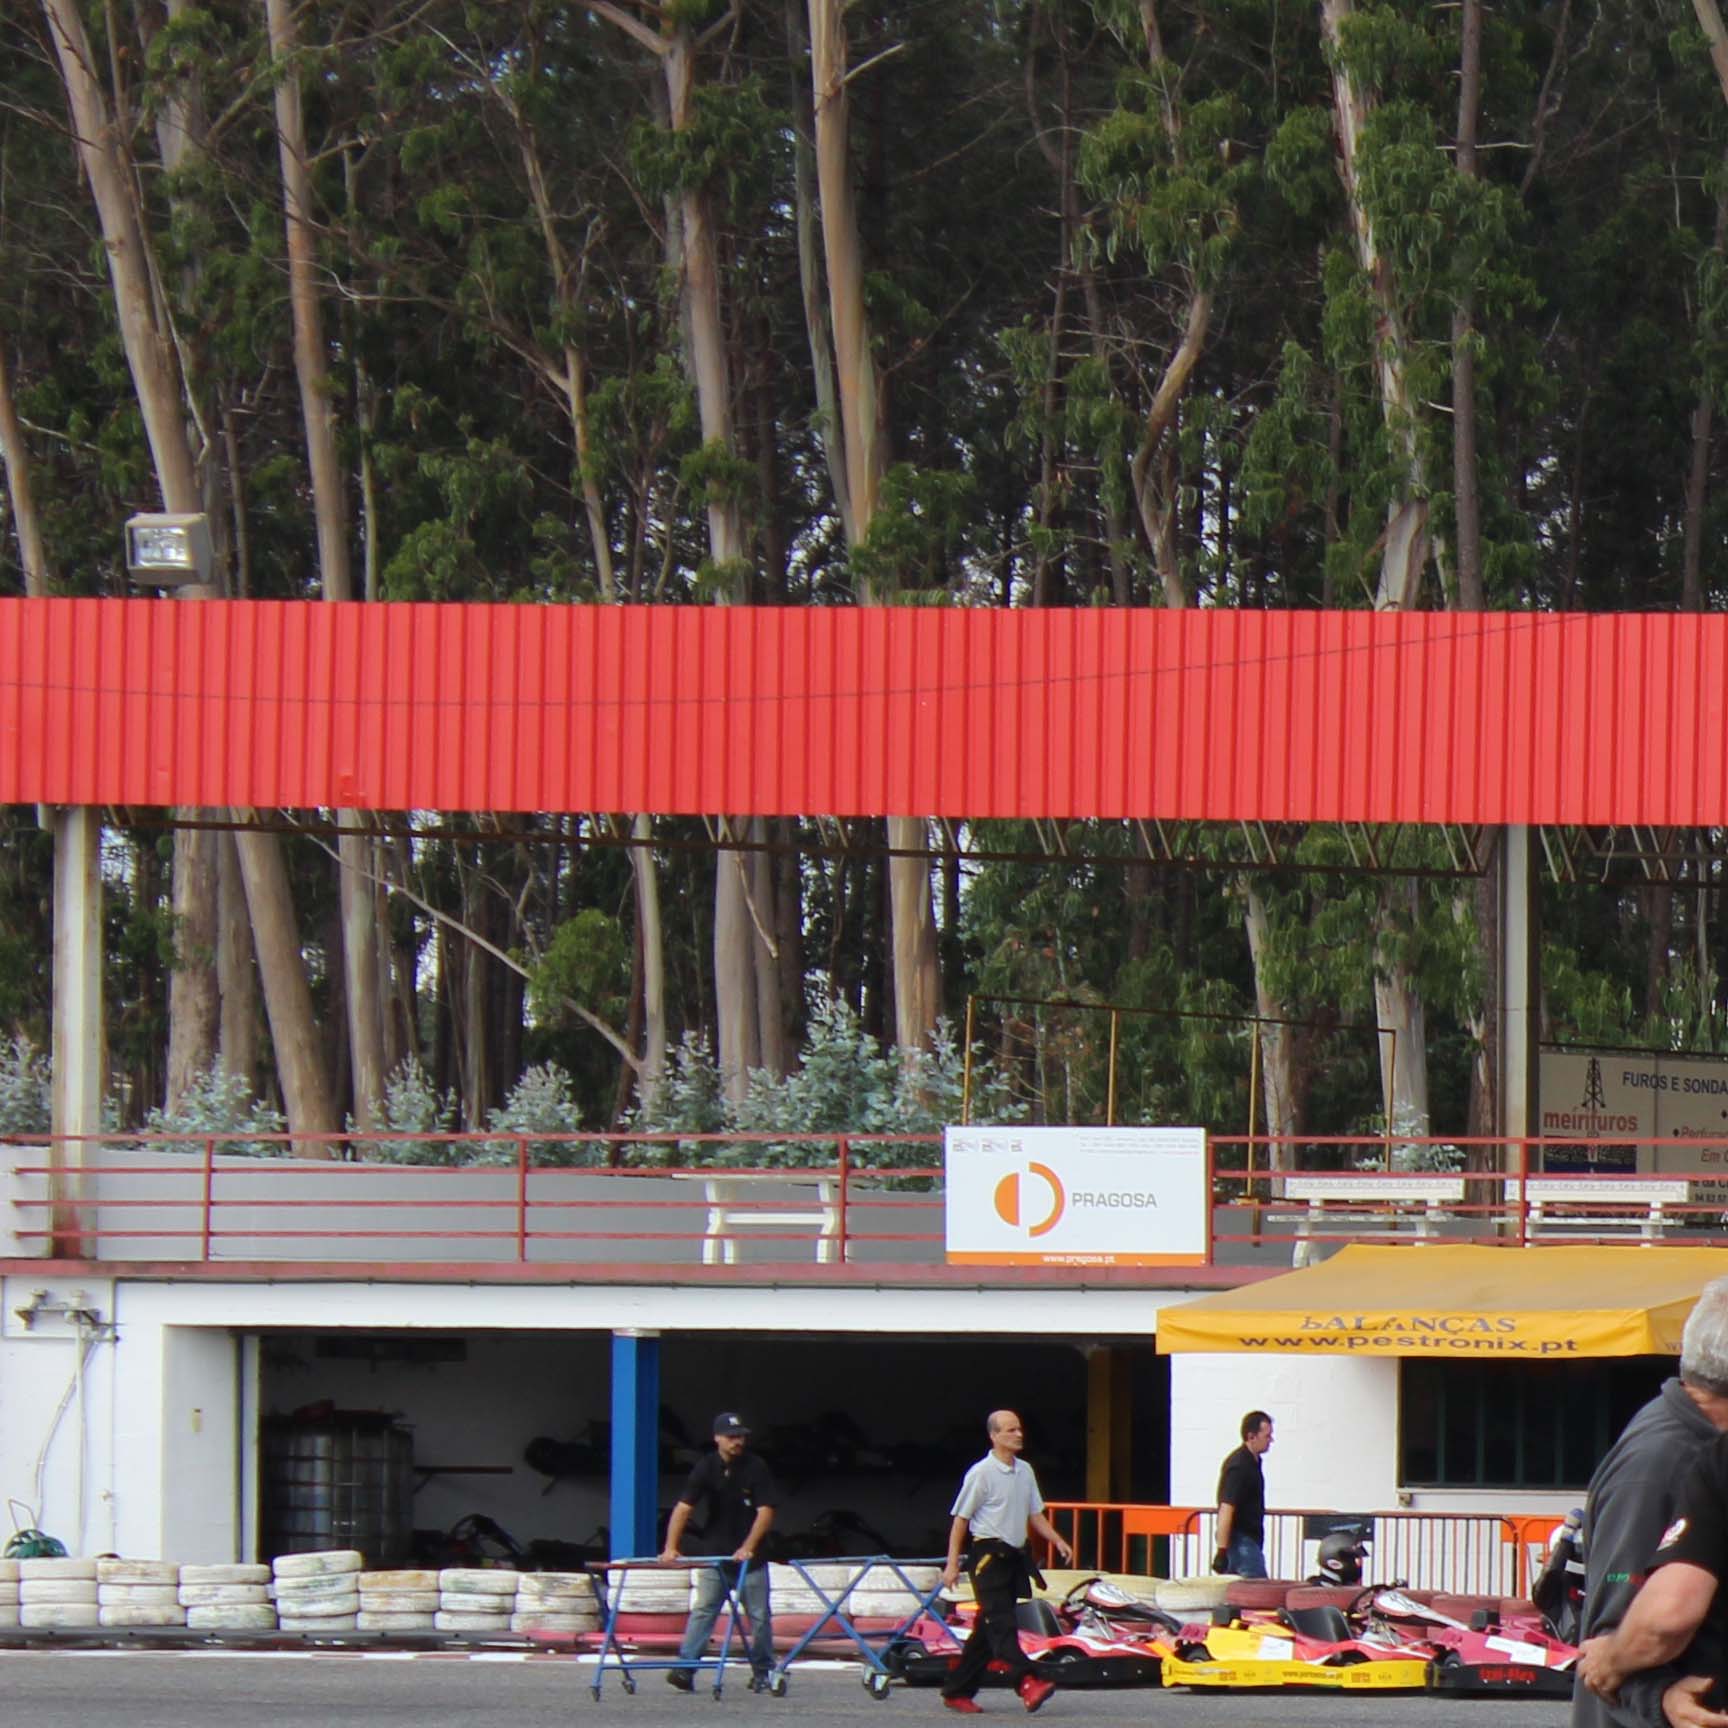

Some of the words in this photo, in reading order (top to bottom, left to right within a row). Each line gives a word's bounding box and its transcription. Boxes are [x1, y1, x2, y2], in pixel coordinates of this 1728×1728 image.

[1622, 1070, 1668, 1090] FUROS
[1671, 1076, 1682, 1092] E
[1700, 1148, 1721, 1163] Em
[1072, 1192, 1158, 1208] PRAGOSA
[1238, 1333, 1579, 1354] www.pestronix.pt
